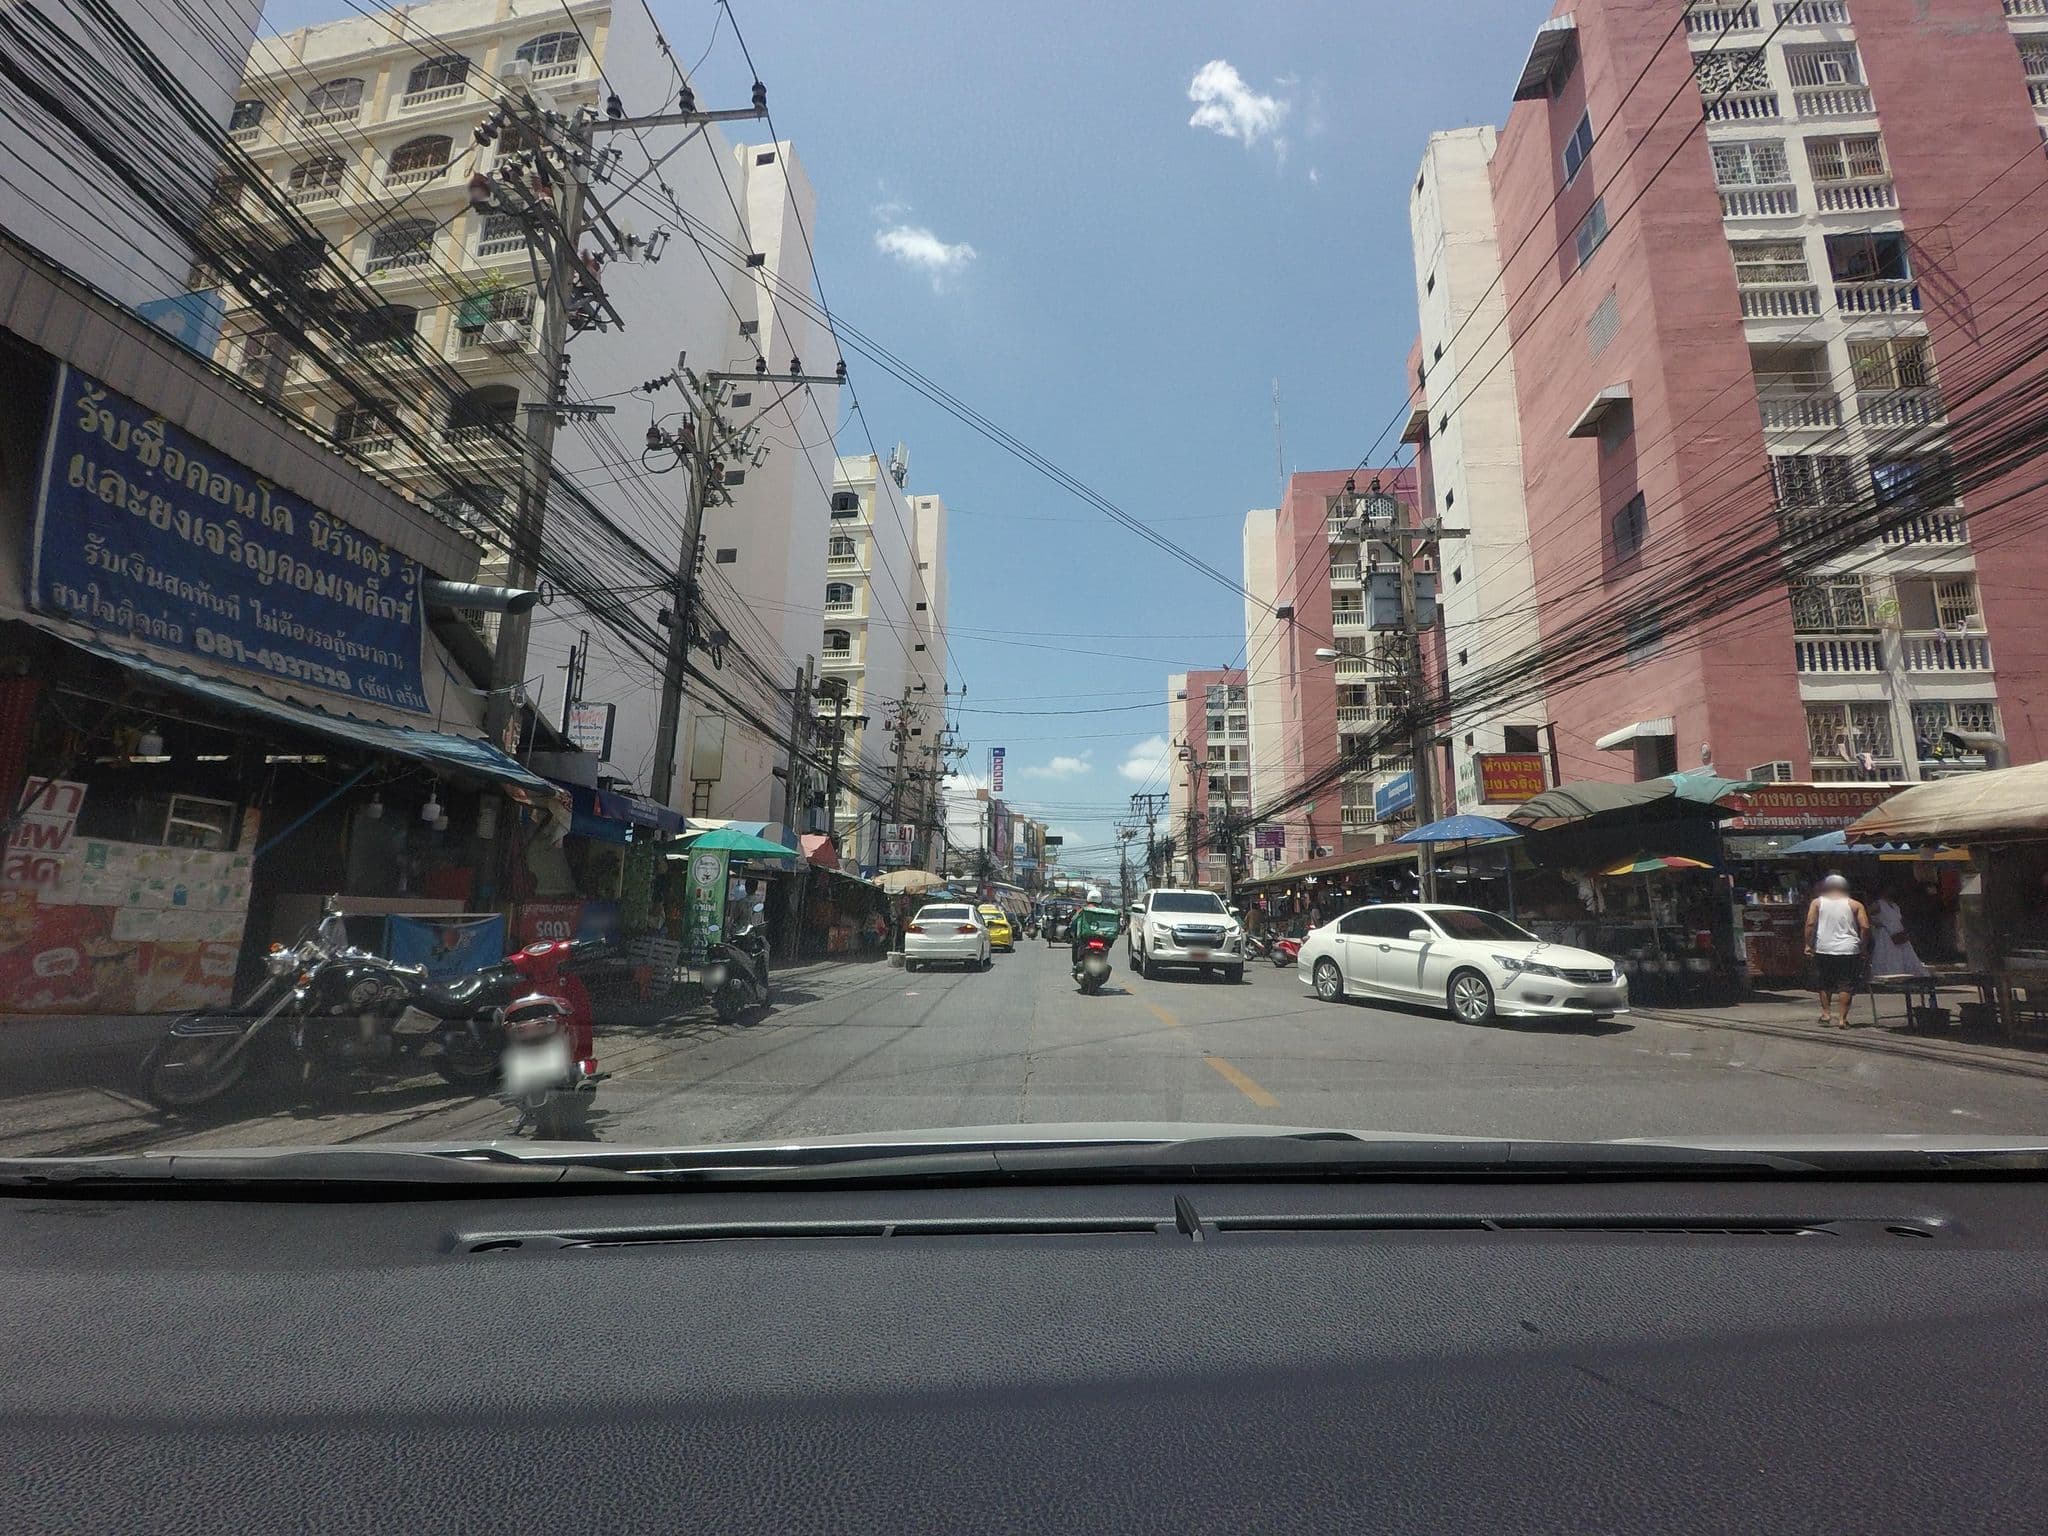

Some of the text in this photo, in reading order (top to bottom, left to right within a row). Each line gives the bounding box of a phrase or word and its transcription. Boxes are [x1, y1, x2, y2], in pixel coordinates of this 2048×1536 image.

[76, 381, 294, 536] รับซื้อคอนโด
[67, 453, 414, 625] และยงเจริญคอมเพล็กซ์
[84, 532, 240, 621] รับเงินสดทันที
[52, 582, 184, 644] สนใจติดต่อ
[194, 626, 353, 690] 081-4937529
